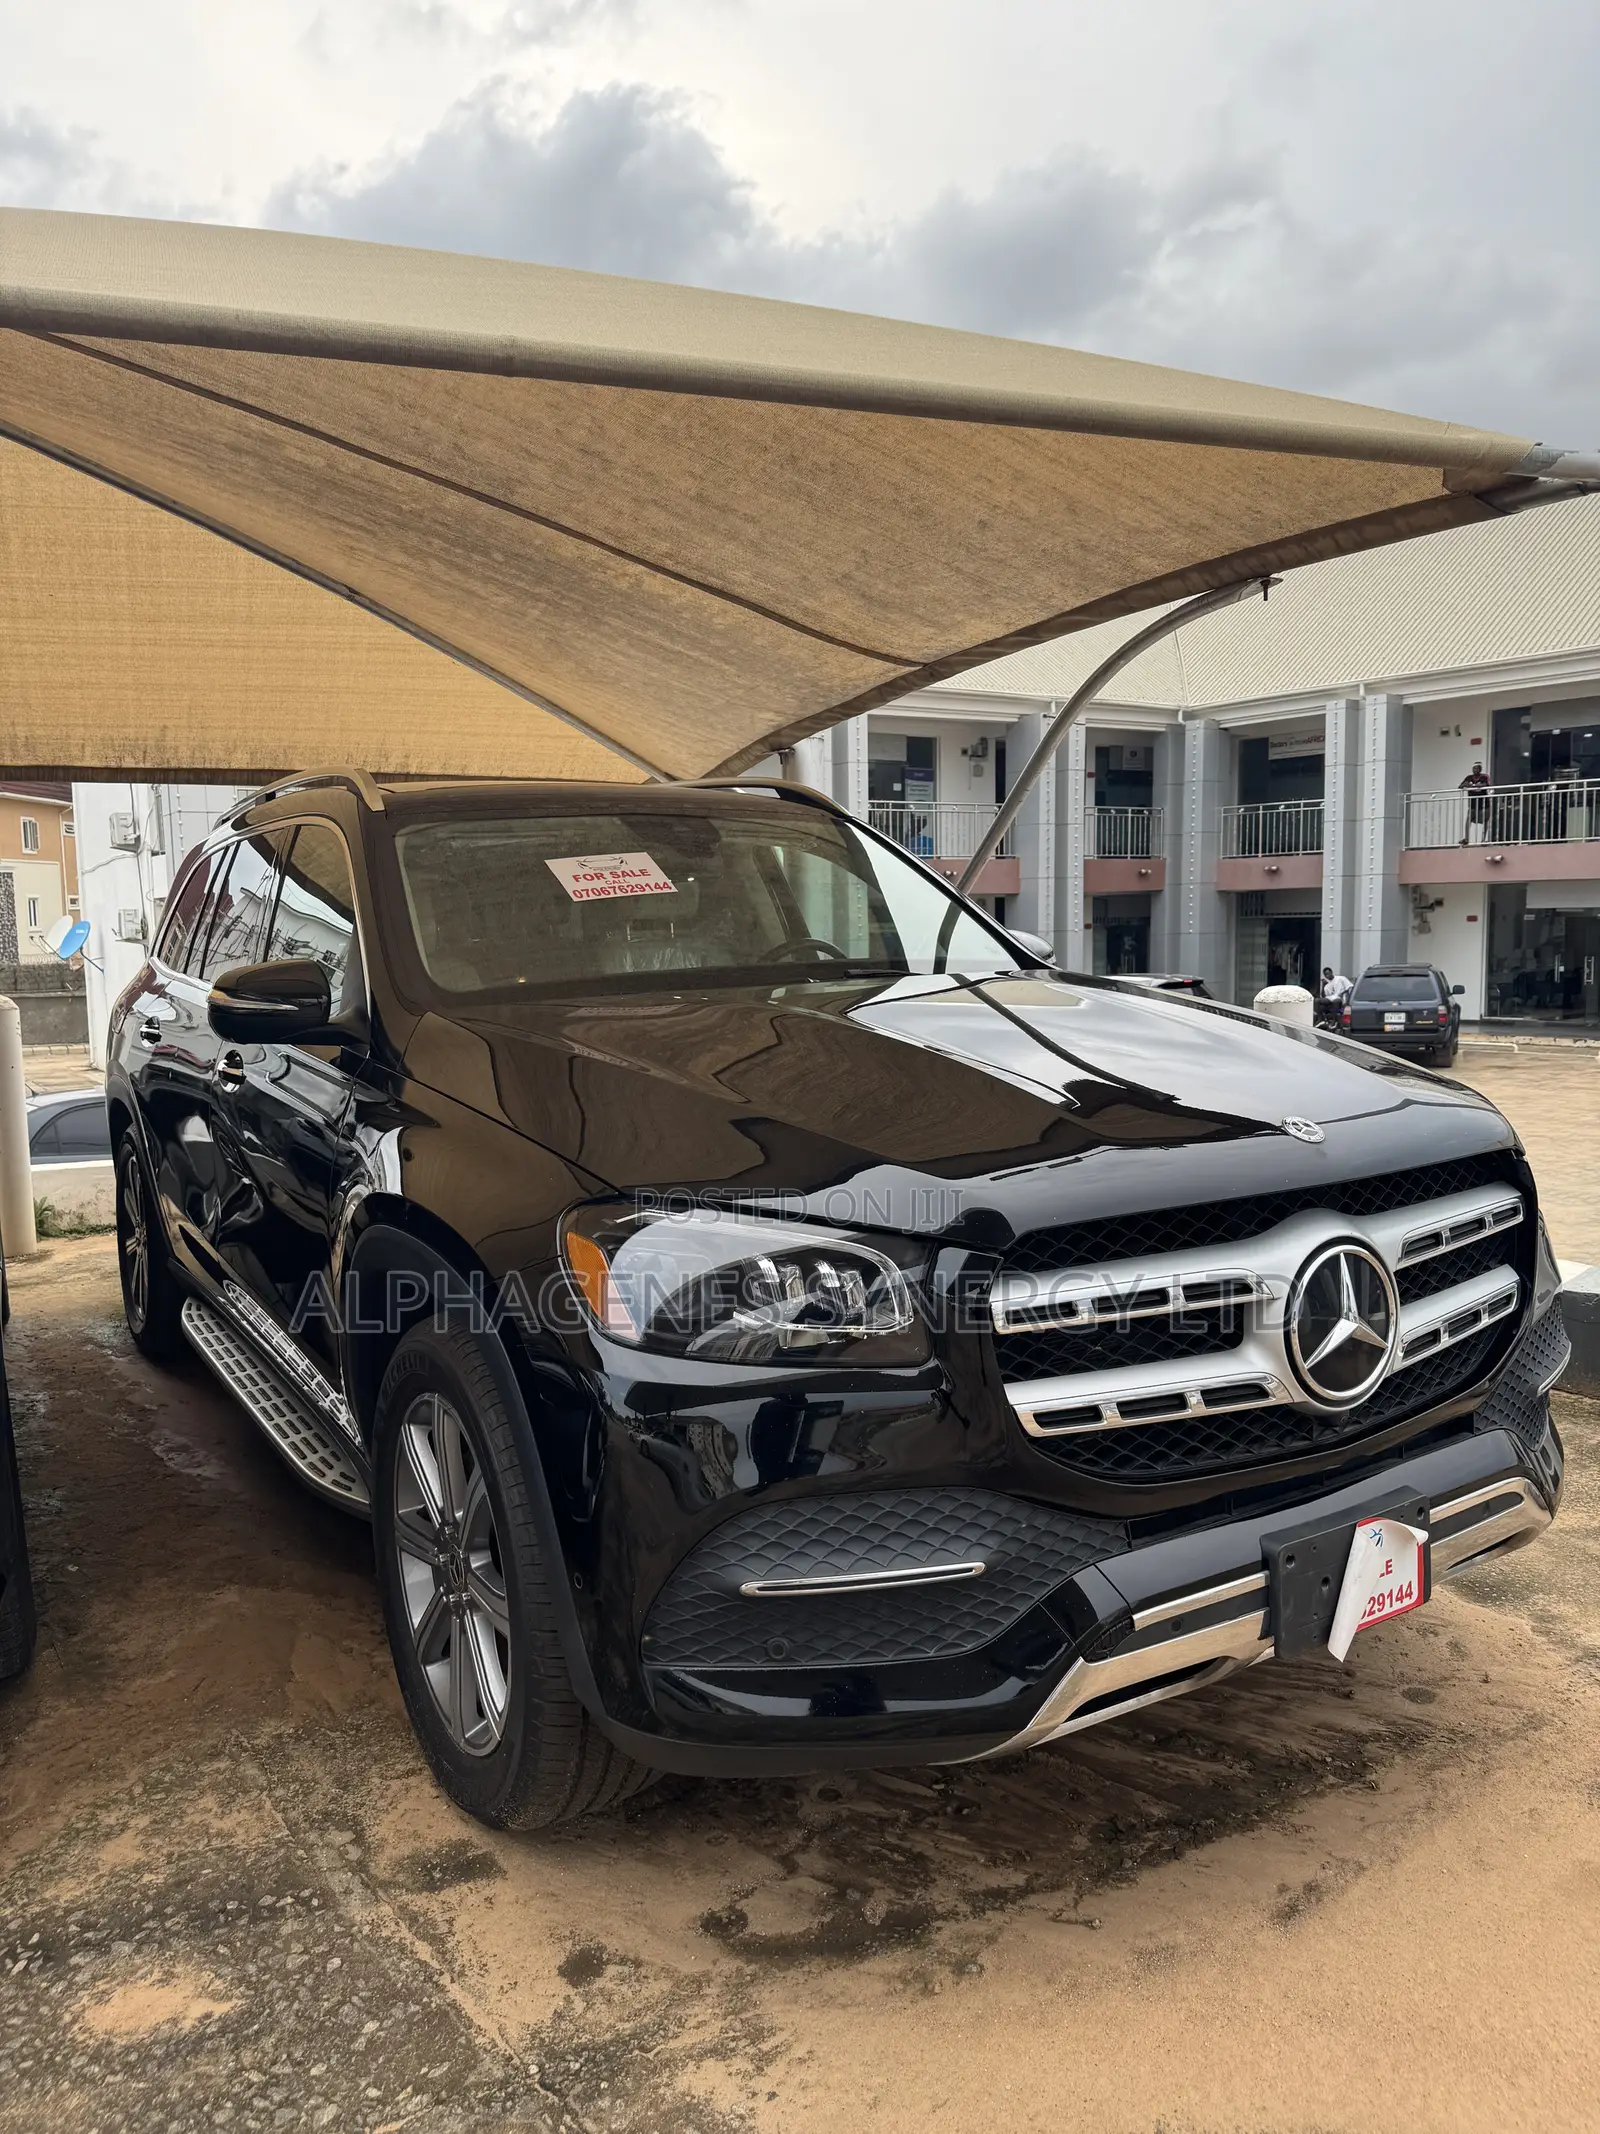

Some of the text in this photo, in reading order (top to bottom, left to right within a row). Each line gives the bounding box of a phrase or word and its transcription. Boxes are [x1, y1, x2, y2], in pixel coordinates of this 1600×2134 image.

[572, 872, 605, 883] FOR
[610, 868, 652, 880] SALE
[572, 881, 672, 899] 07067629144
[1361, 1580, 1413, 1619] 29144
